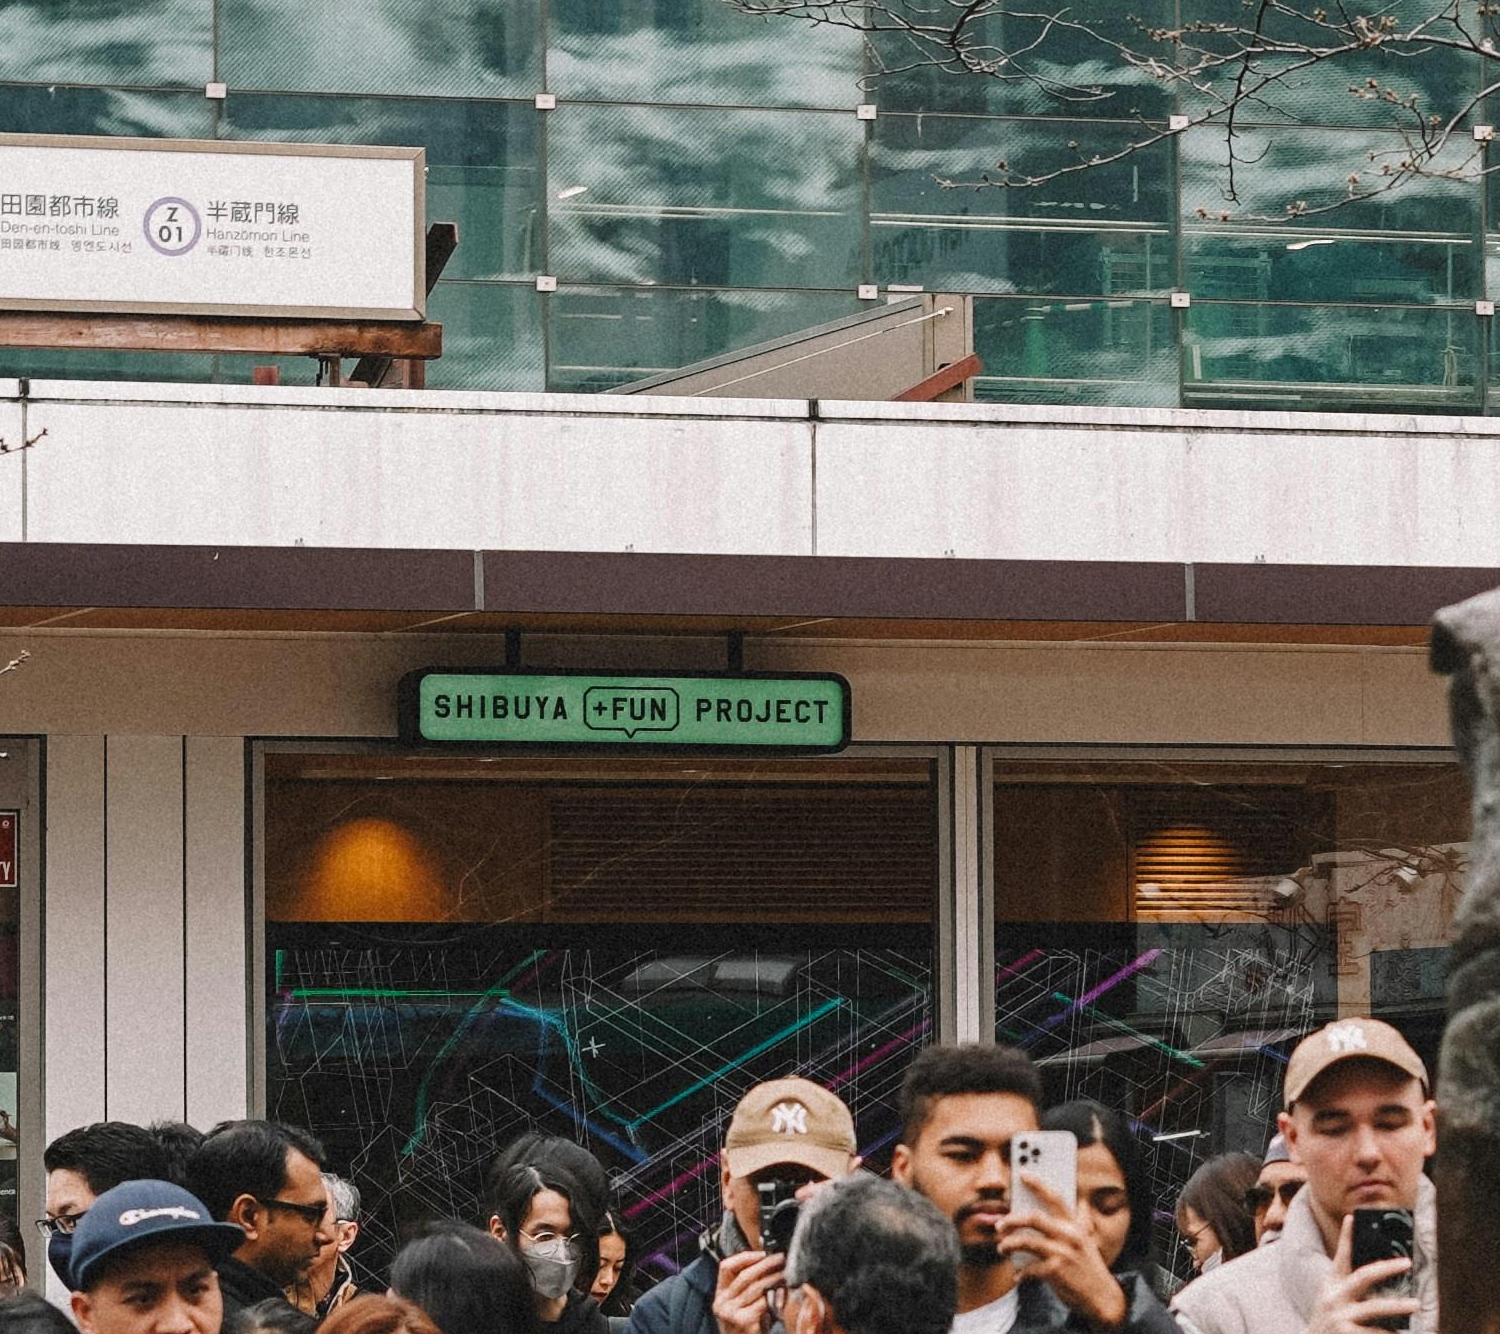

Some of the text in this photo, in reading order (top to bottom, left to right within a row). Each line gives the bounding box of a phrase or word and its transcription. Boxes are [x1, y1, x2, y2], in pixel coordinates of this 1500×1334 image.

[1, 193, 120, 219] 田園都市線
[166, 207, 178, 223] Z
[205, 200, 300, 225] 半蔵門線
[1, 220, 120, 237] Den-en-toshi Line
[158, 226, 184, 244] 01
[282, 229, 310, 243] Line
[433, 693, 830, 725] SHIBUYA +FUN PROJECT
